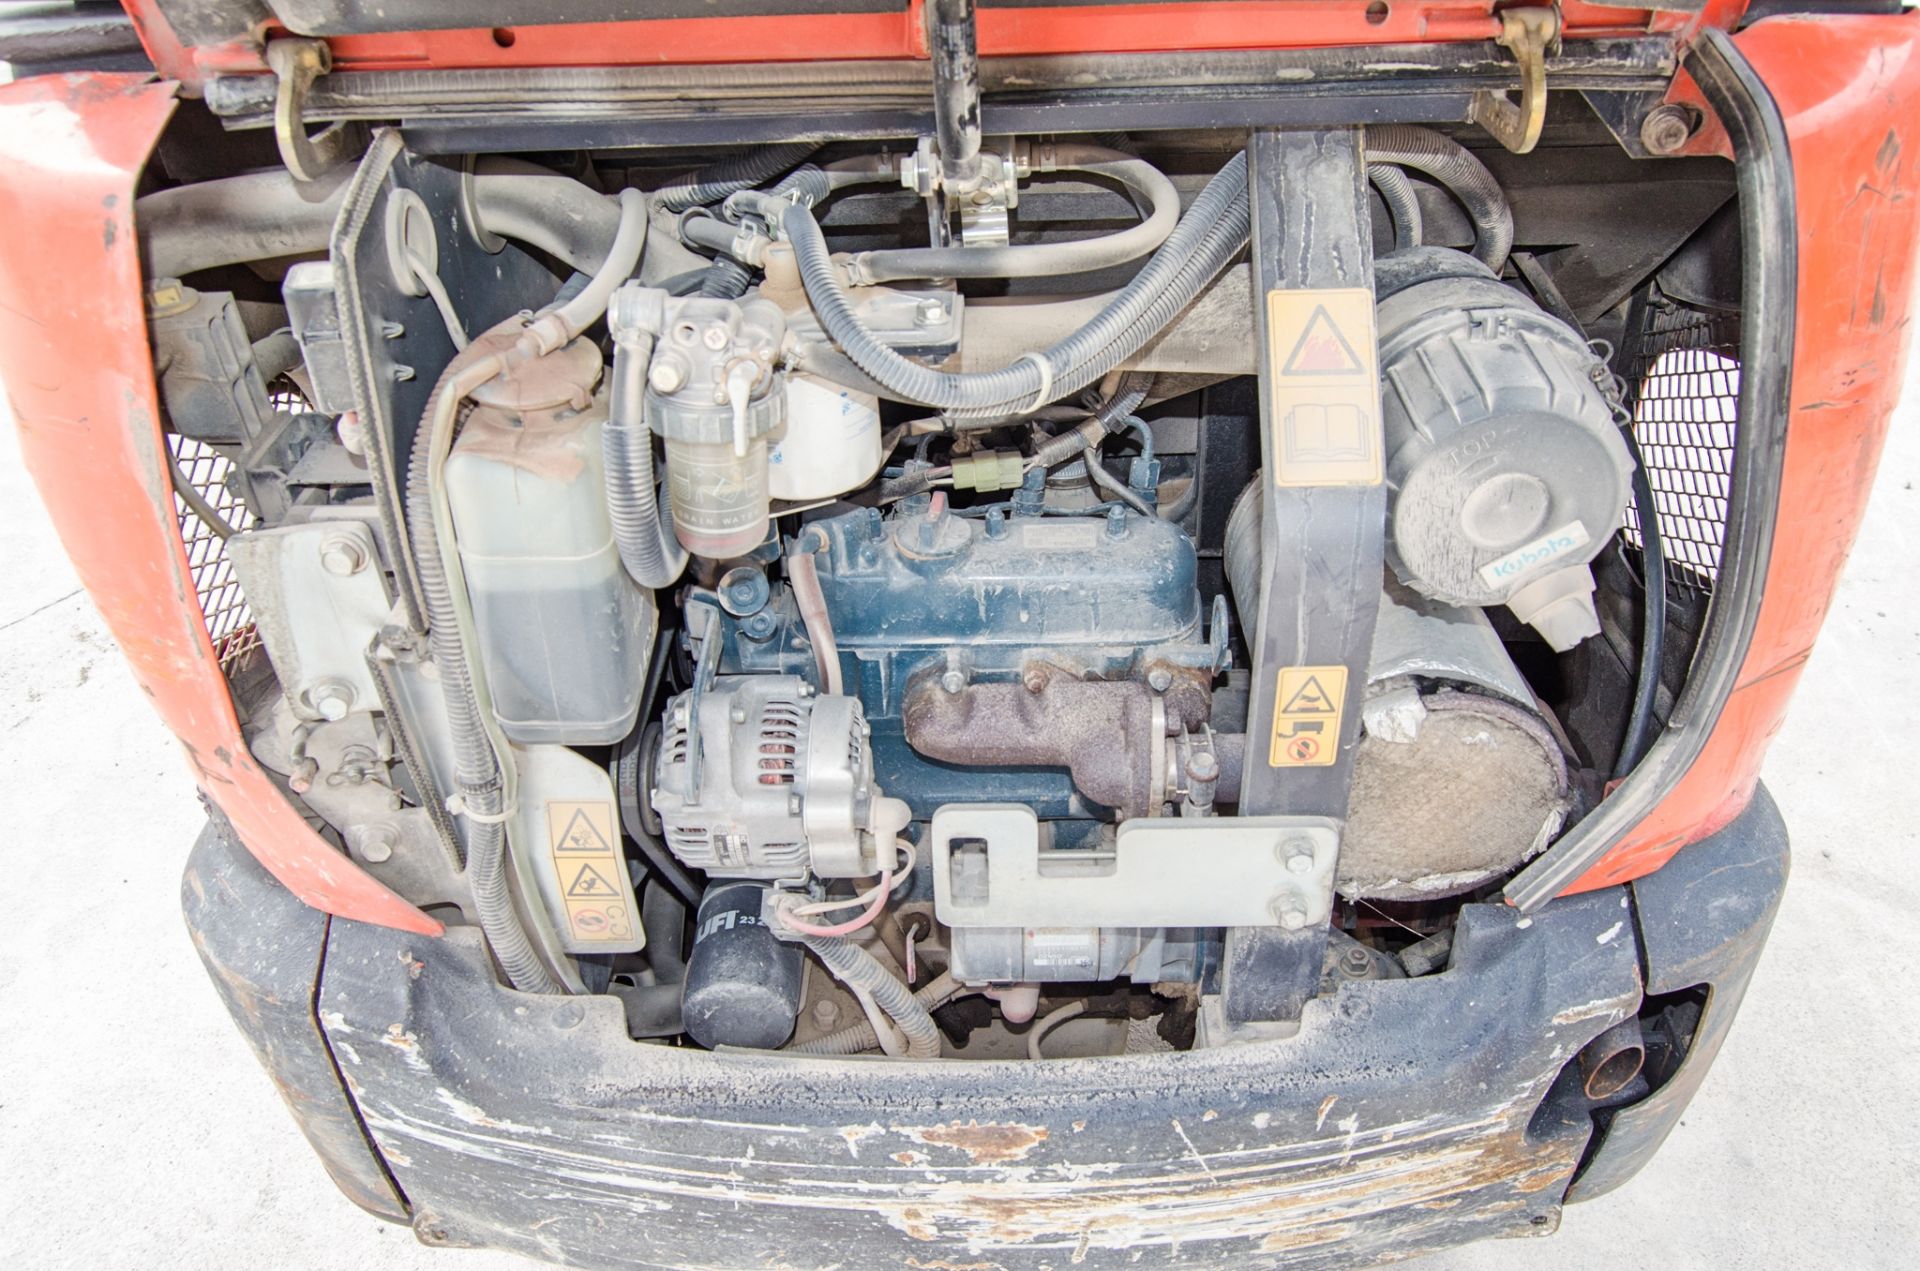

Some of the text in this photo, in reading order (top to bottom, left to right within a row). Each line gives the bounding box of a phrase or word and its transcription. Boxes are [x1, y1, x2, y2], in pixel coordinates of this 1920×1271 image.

[1448, 430, 1497, 466] TOP
[1494, 535, 1577, 578] Kubota
[696, 910, 739, 944] UFI
